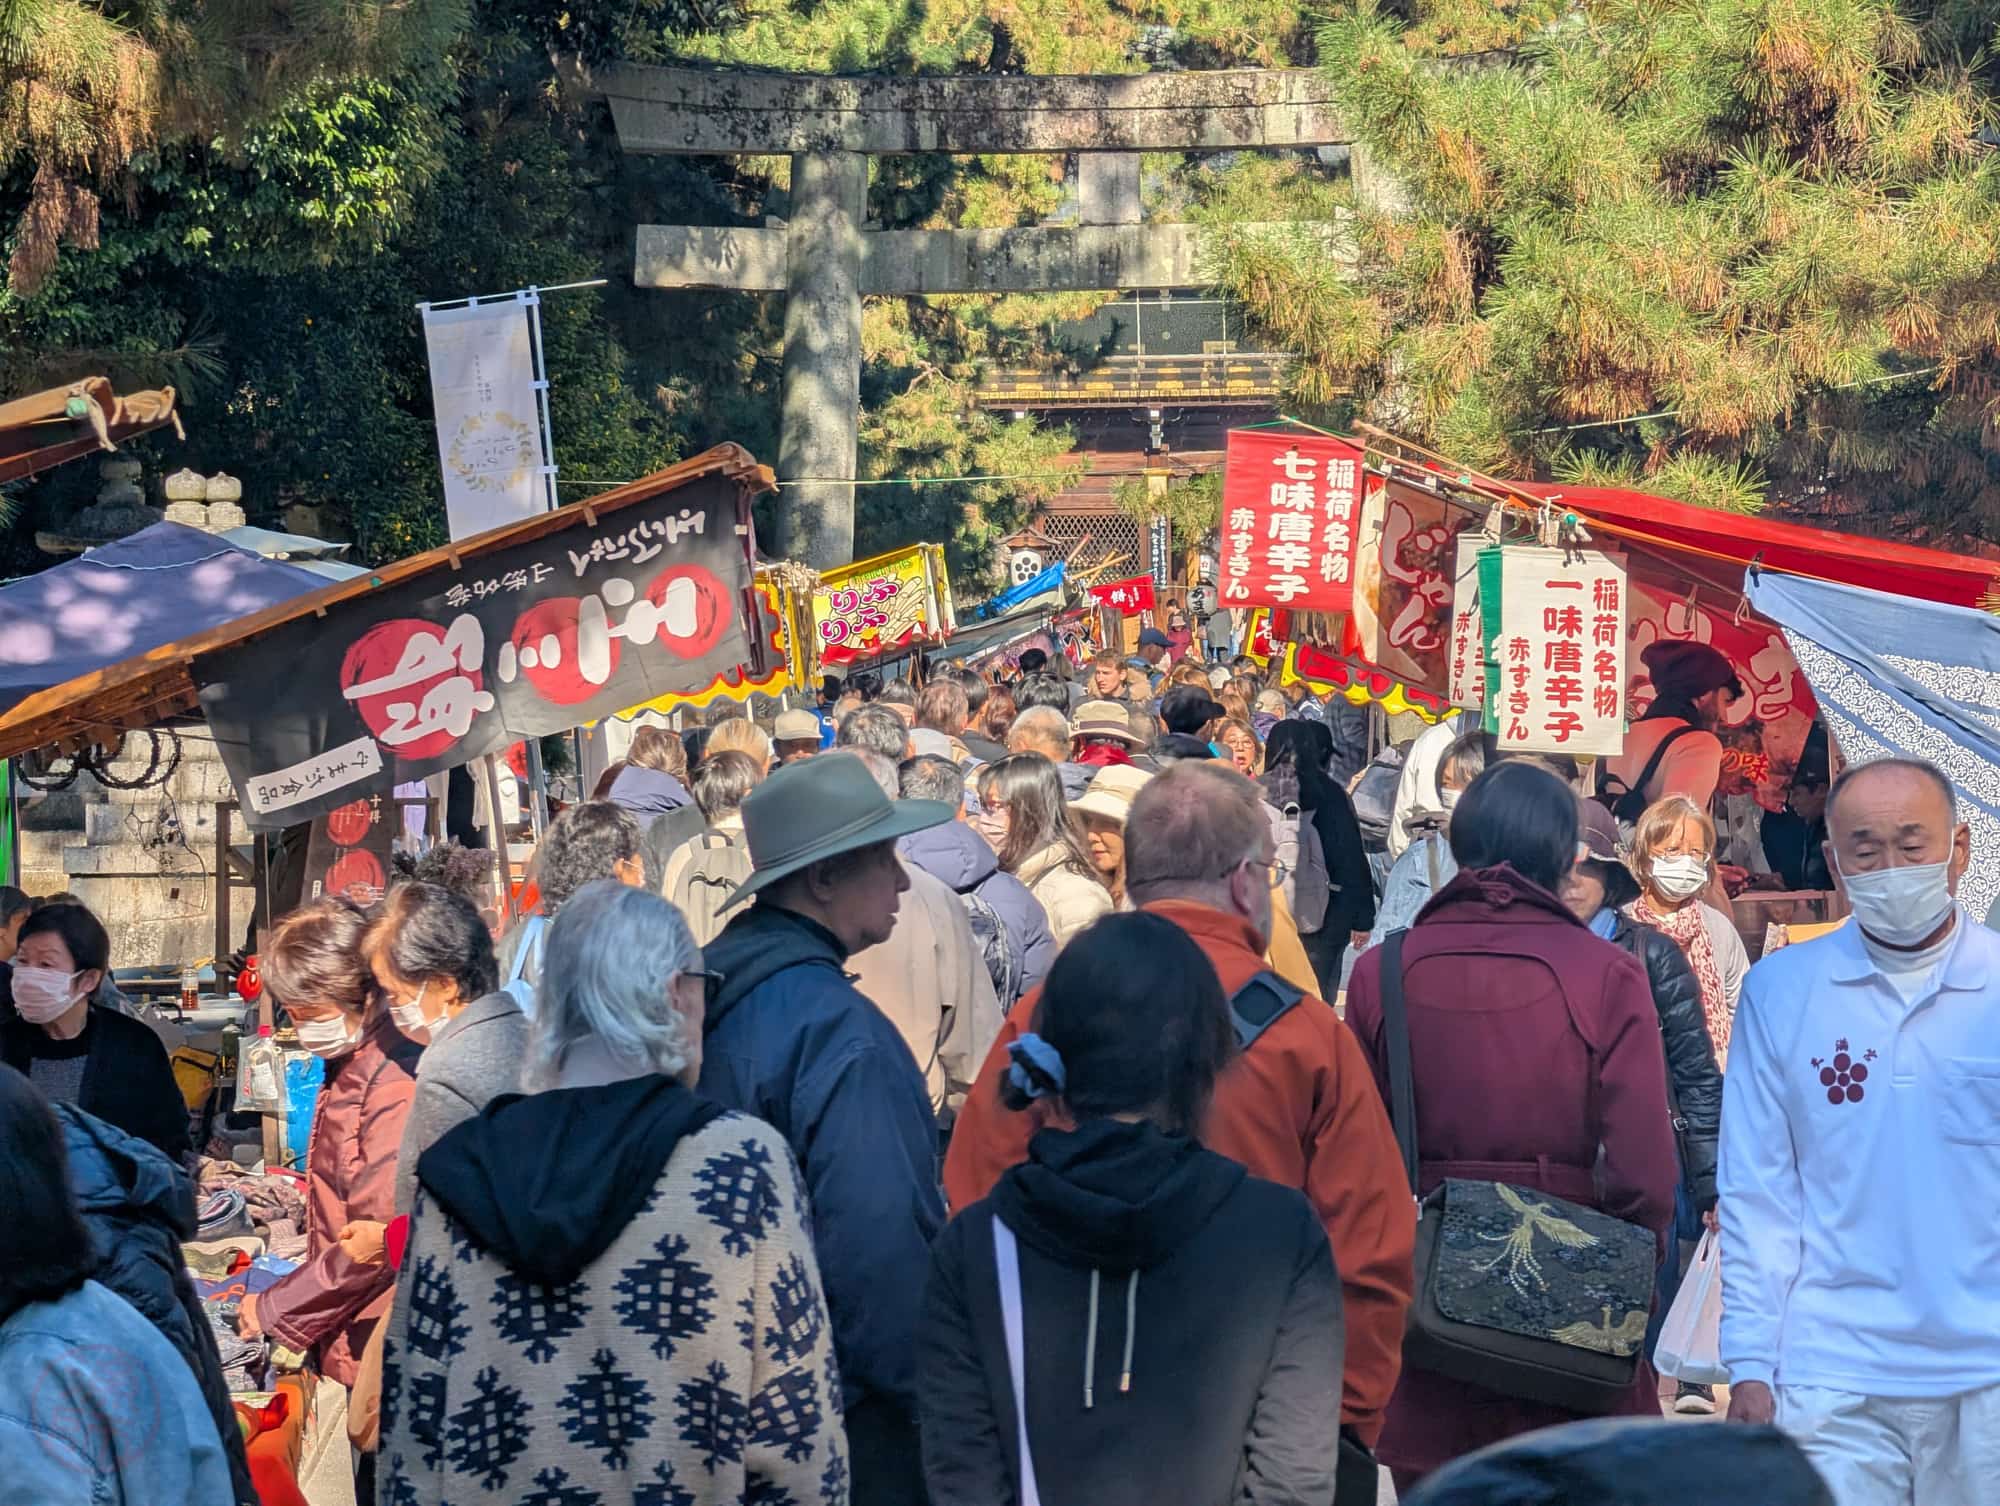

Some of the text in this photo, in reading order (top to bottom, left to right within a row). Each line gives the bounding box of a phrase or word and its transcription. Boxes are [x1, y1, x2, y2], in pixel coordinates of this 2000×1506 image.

[1225, 507, 1255, 600] 赤ずきん
[1264, 450, 1317, 602] 七味唐辛子
[1320, 458, 1355, 583] 稲荷名物
[1452, 611, 1470, 702] 赤ずきん
[1507, 637, 1530, 741] 赤ずきん
[1544, 579, 1584, 743] 一味唐辛子
[1593, 578, 1619, 719] 稲荷名物
